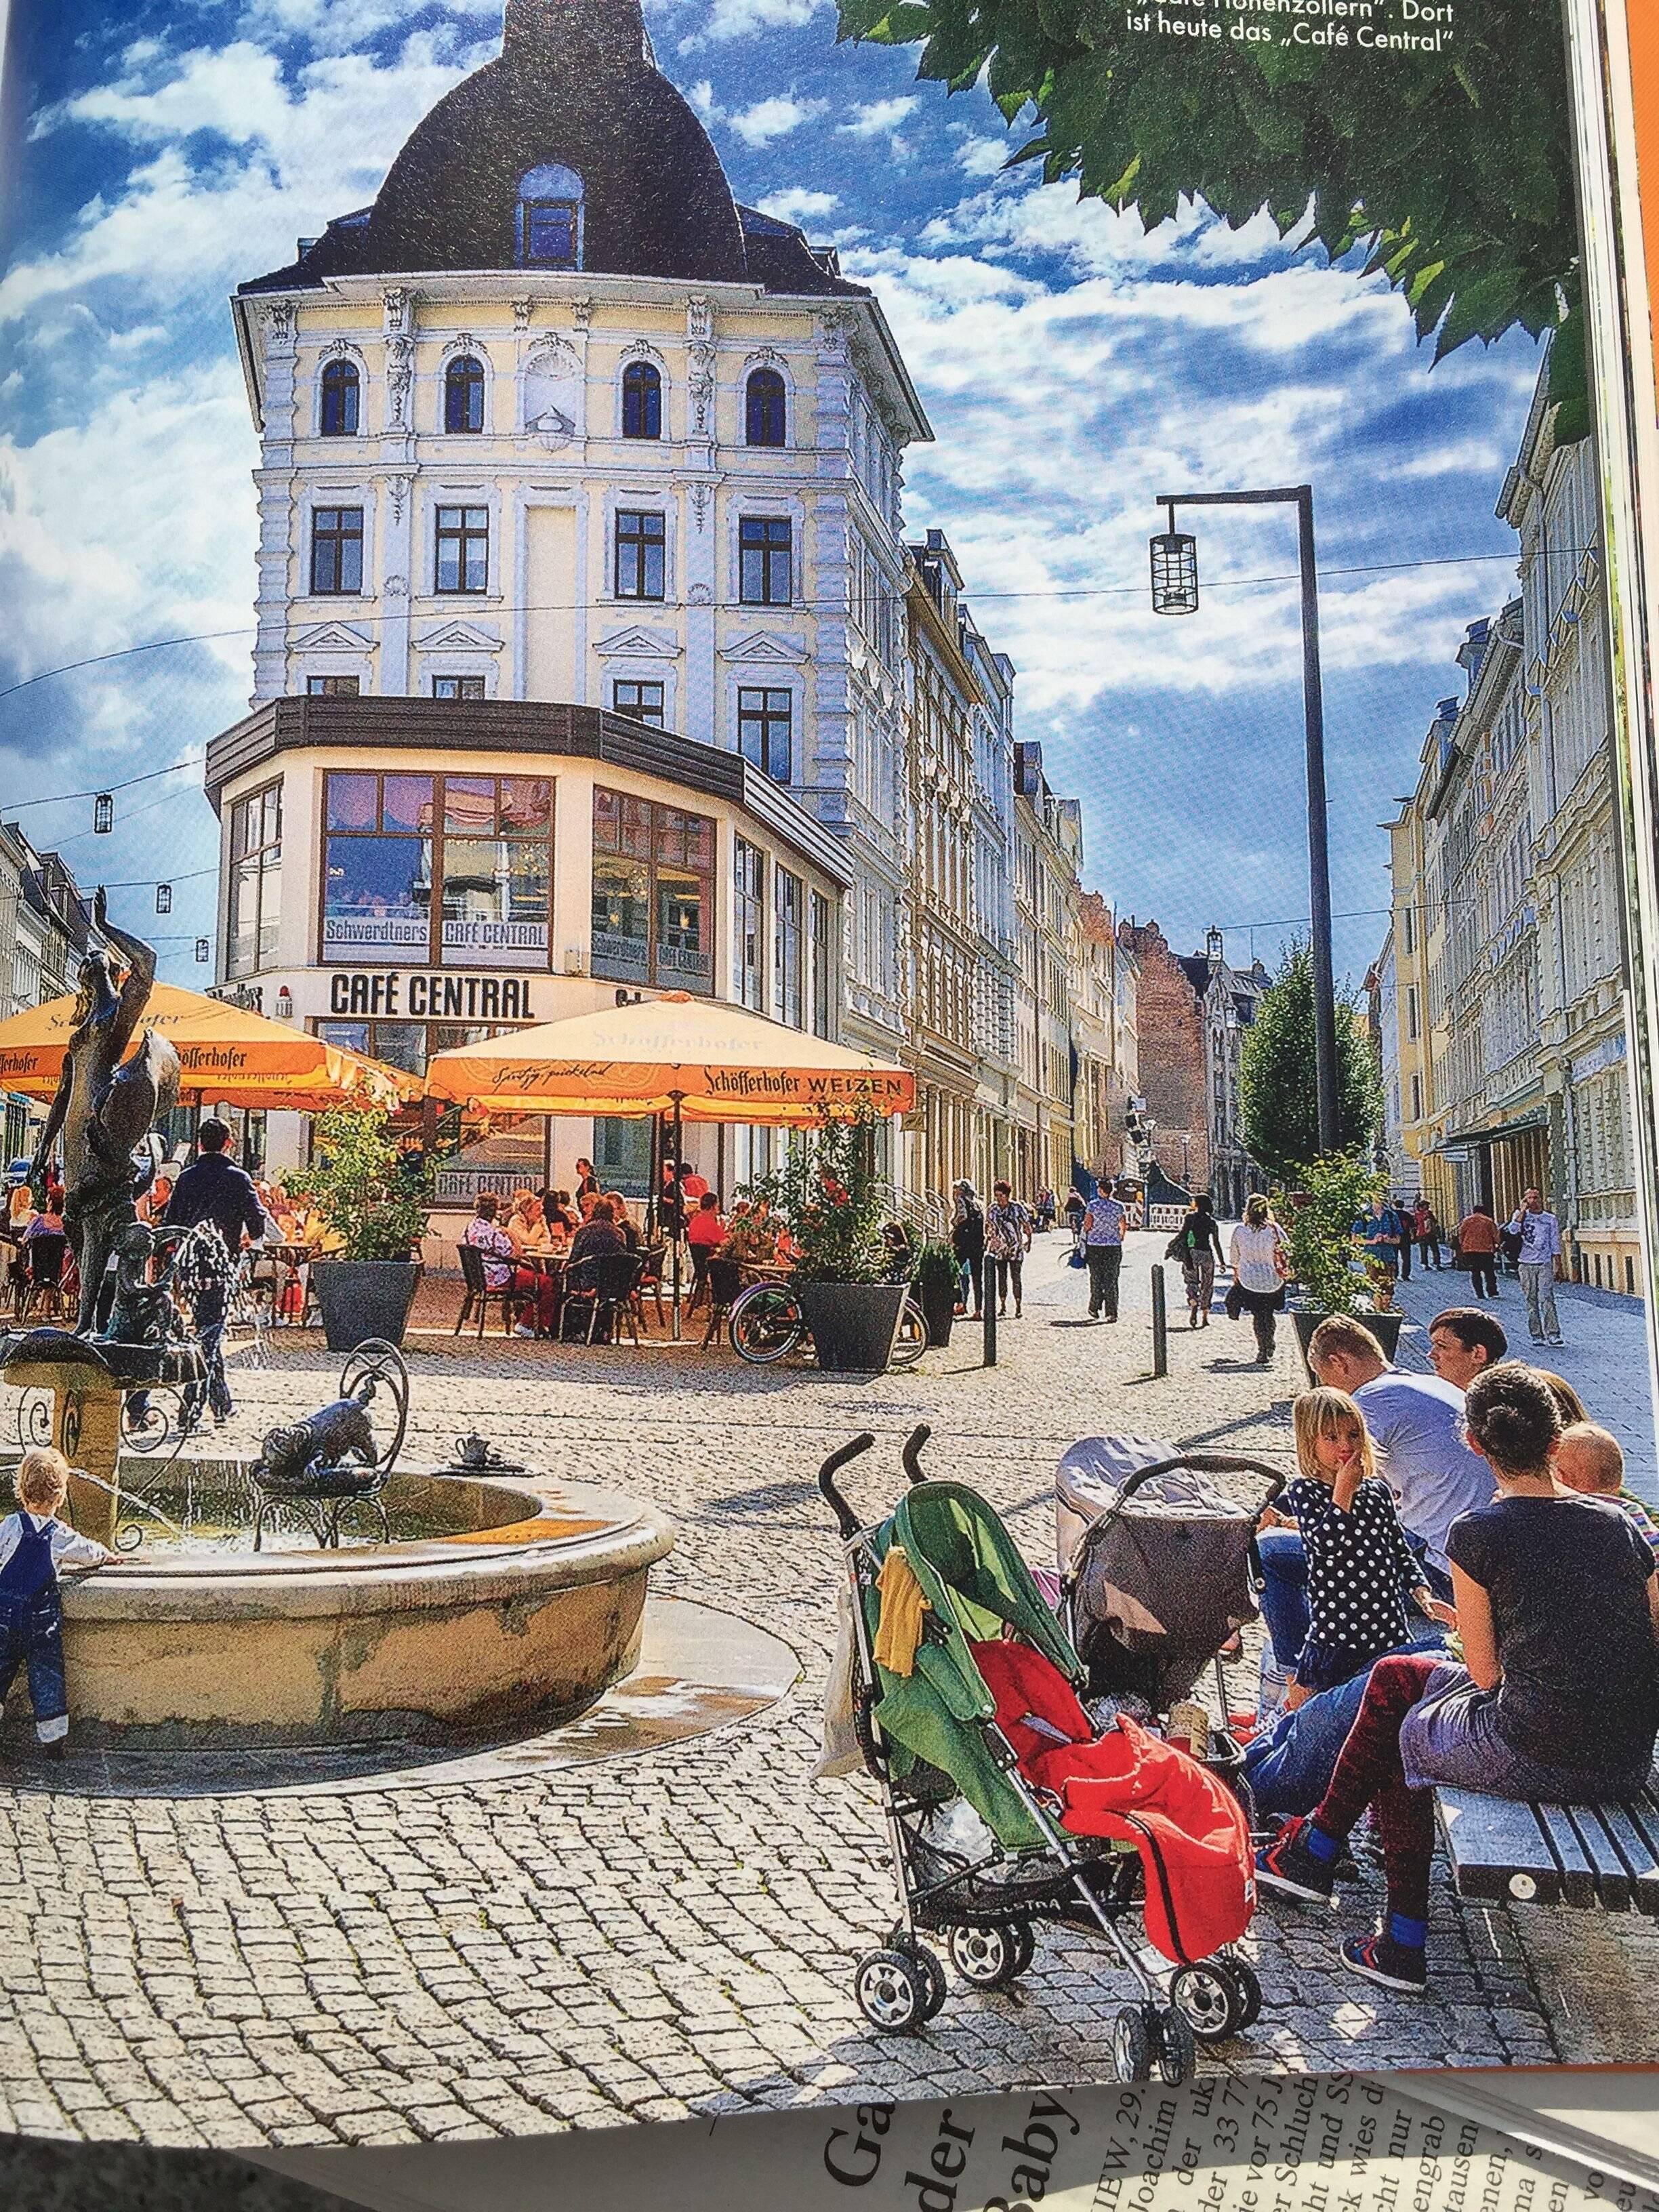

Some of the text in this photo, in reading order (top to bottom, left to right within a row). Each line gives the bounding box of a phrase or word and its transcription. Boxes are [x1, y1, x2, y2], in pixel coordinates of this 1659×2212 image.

[1126, 9, 1151, 31] ist
[1158, 9, 1222, 39] heute
[1229, 16, 1272, 42] das
[1403, 0, 1454, 22] Dort
[483, 924, 545, 945] CENTRAL
[330, 971, 535, 1019] CAFÉ CENTRAL
[703, 1064, 902, 1096] Schöfferhofer WEIZEN
[1251, 2094, 1279, 2129] 75
[1326, 2074, 1354, 2105] SS
[1091, 2088, 1146, 2212] IEW, 29.
[1128, 2100, 1178, 2212] Joachim
[1213, 2116, 1240, 2153] 33
[1274, 2076, 1319, 2187] Schluch
[1317, 2112, 1343, 2170] und
[1349, 2114, 1377, 2176] wies
[1388, 2108, 1412, 2161] nur
[904, 2108, 976, 2212] der
[1171, 2137, 1202, 2186] der
[1246, 2135, 1271, 2182] vor
[1413, 2114, 1446, 2212] engrab
[1442, 2118, 1479, 2212] tausen
